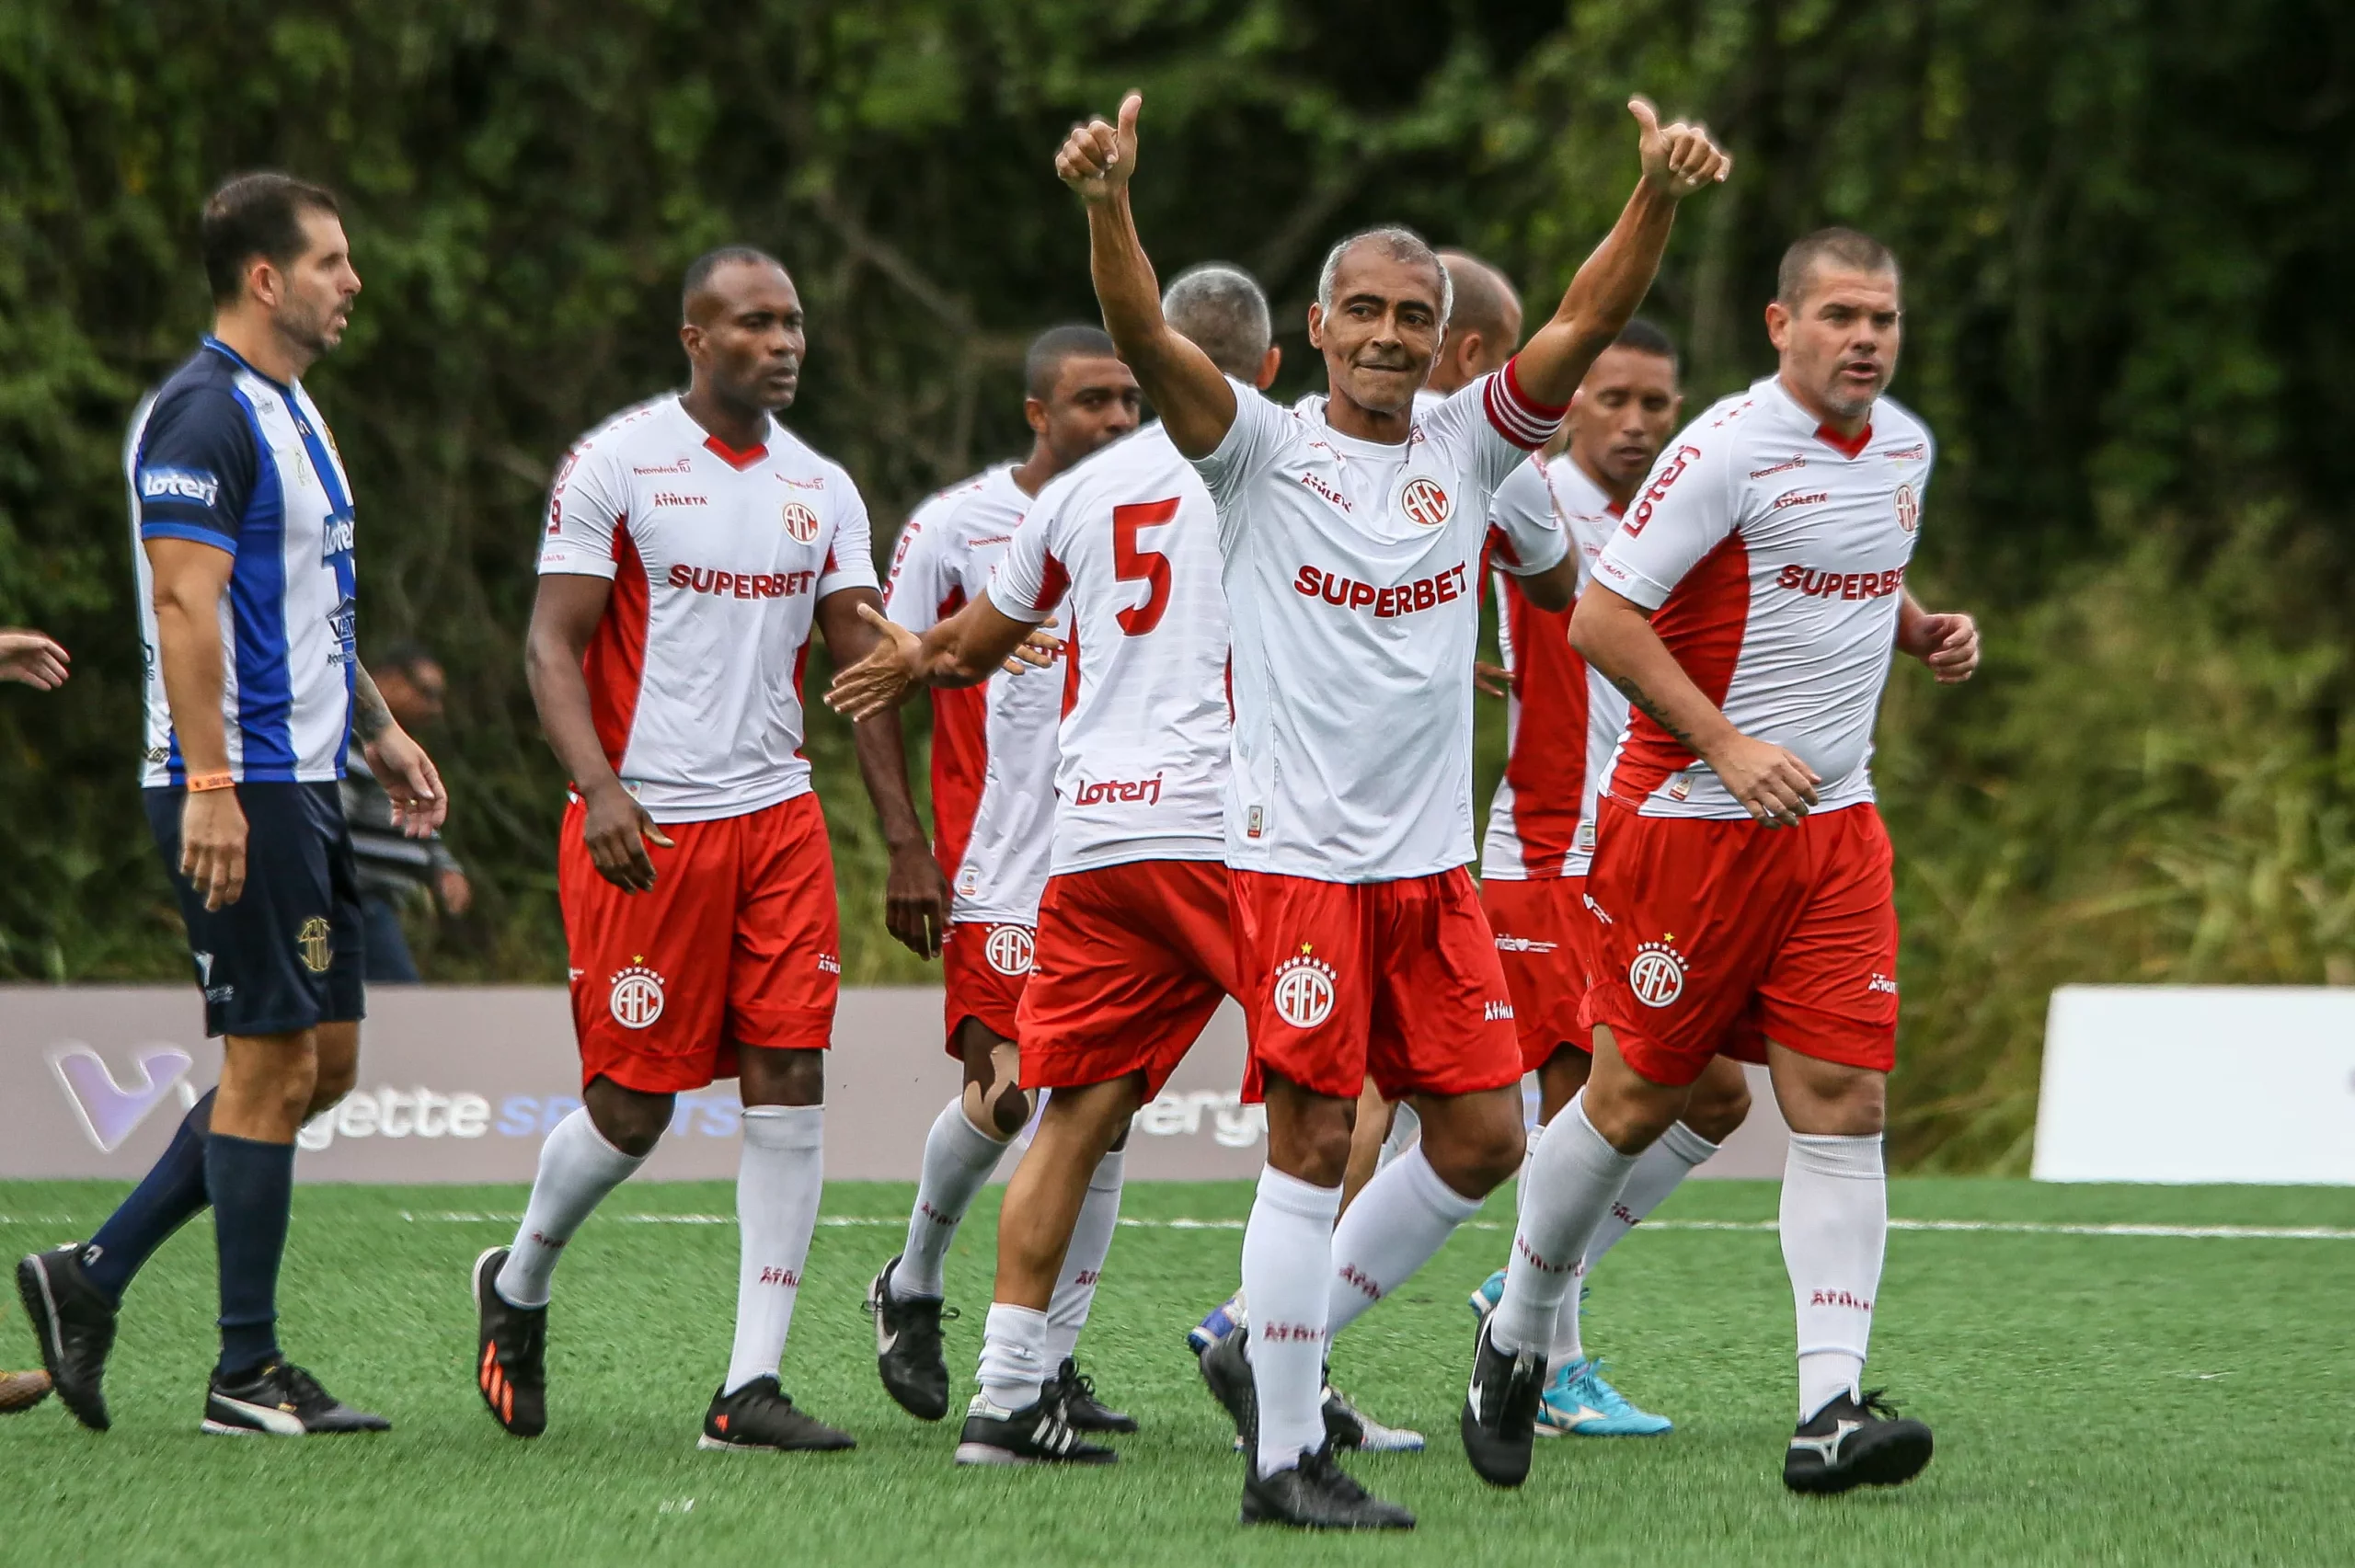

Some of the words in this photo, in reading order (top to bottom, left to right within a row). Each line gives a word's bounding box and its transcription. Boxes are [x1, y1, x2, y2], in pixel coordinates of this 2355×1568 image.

[144, 474, 219, 508] Loterj
[654, 494, 708, 508] ATHLETA
[1622, 445, 1701, 540] Loterj
[668, 564, 816, 601] SUPERBET
[1113, 497, 1182, 636] 5
[1293, 560, 1468, 618] SUPERBET
[1074, 771, 1164, 807] Loterj
